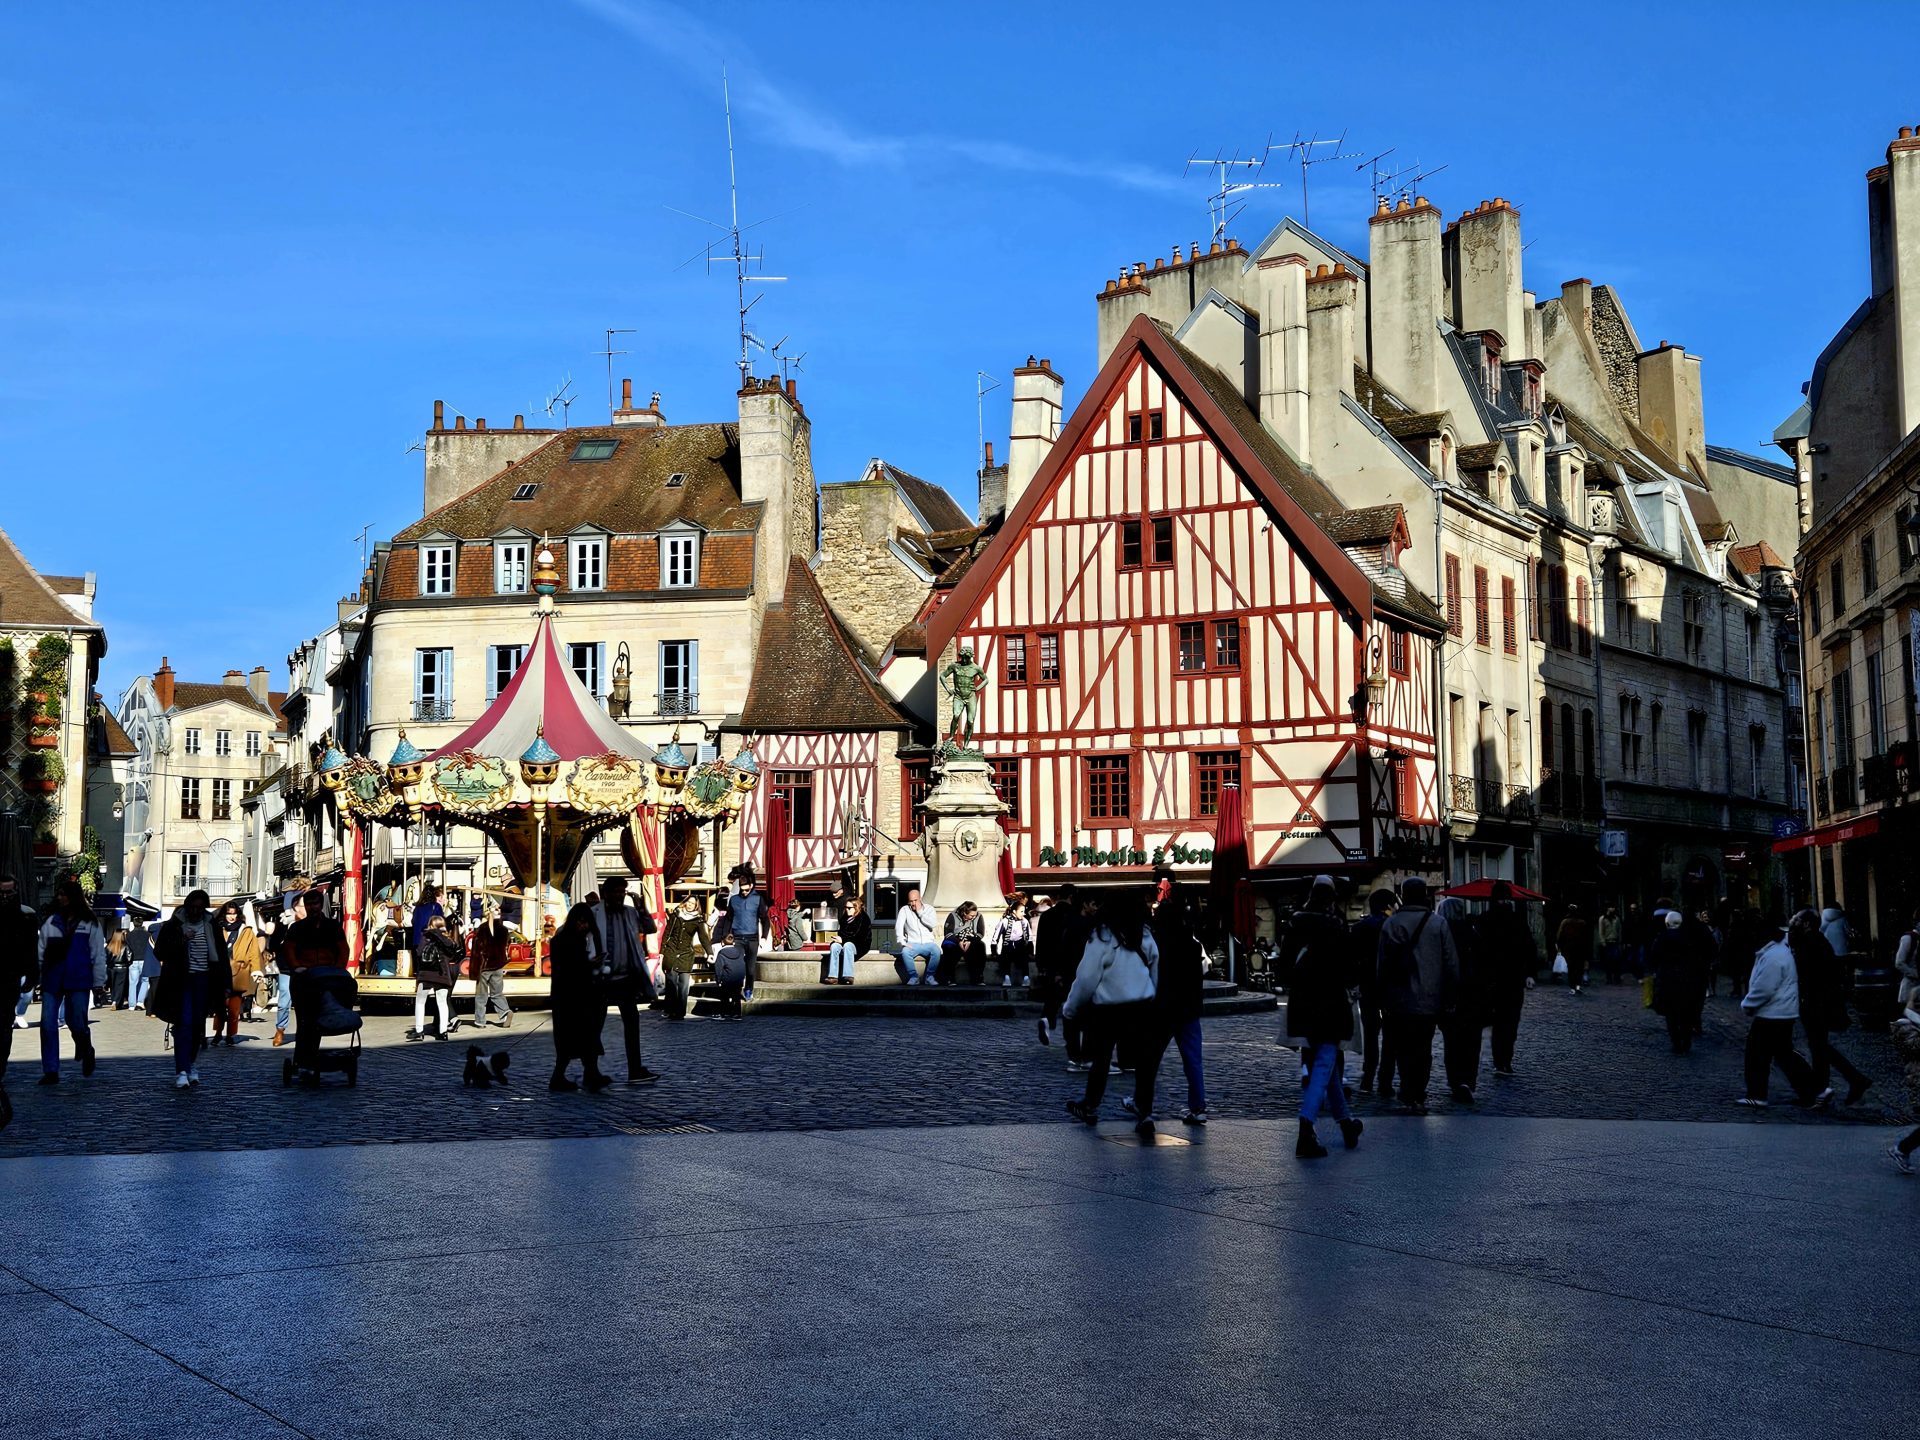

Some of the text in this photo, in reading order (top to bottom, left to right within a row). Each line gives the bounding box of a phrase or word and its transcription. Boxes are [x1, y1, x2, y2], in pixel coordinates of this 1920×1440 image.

[585, 771, 632, 781] Carrousel
[1280, 830, 1329, 840] Restauran
[1038, 845, 1068, 867] Au
[1071, 844, 1148, 868] Moulin
[1170, 841, 1214, 865] Ven
